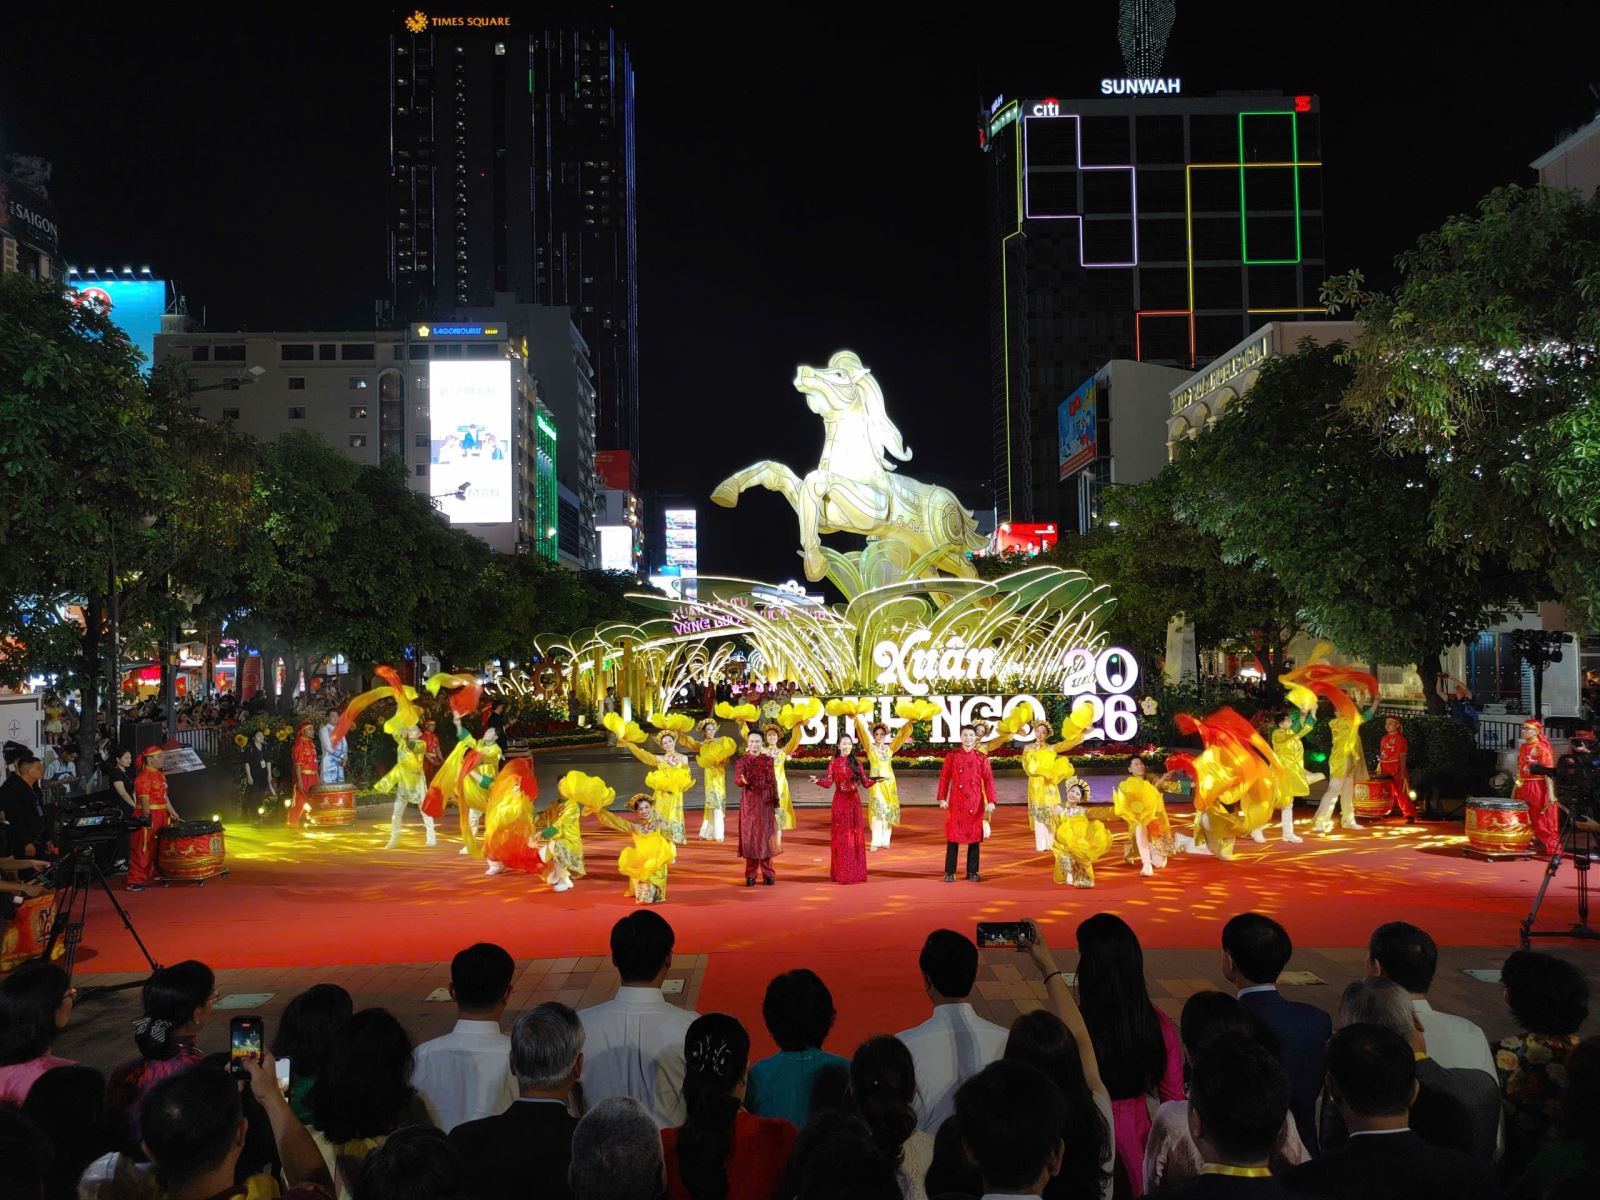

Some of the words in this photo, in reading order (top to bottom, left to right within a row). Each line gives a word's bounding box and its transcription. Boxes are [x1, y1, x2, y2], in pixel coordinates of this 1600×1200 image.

[431, 17, 464, 27] TIMES
[467, 17, 511, 28] SQUARE
[1100, 78, 1181, 95] SUNWAH
[1033, 102, 1060, 116] citi
[16, 203, 58, 238] SAIGON
[873, 628, 996, 696] Xuân
